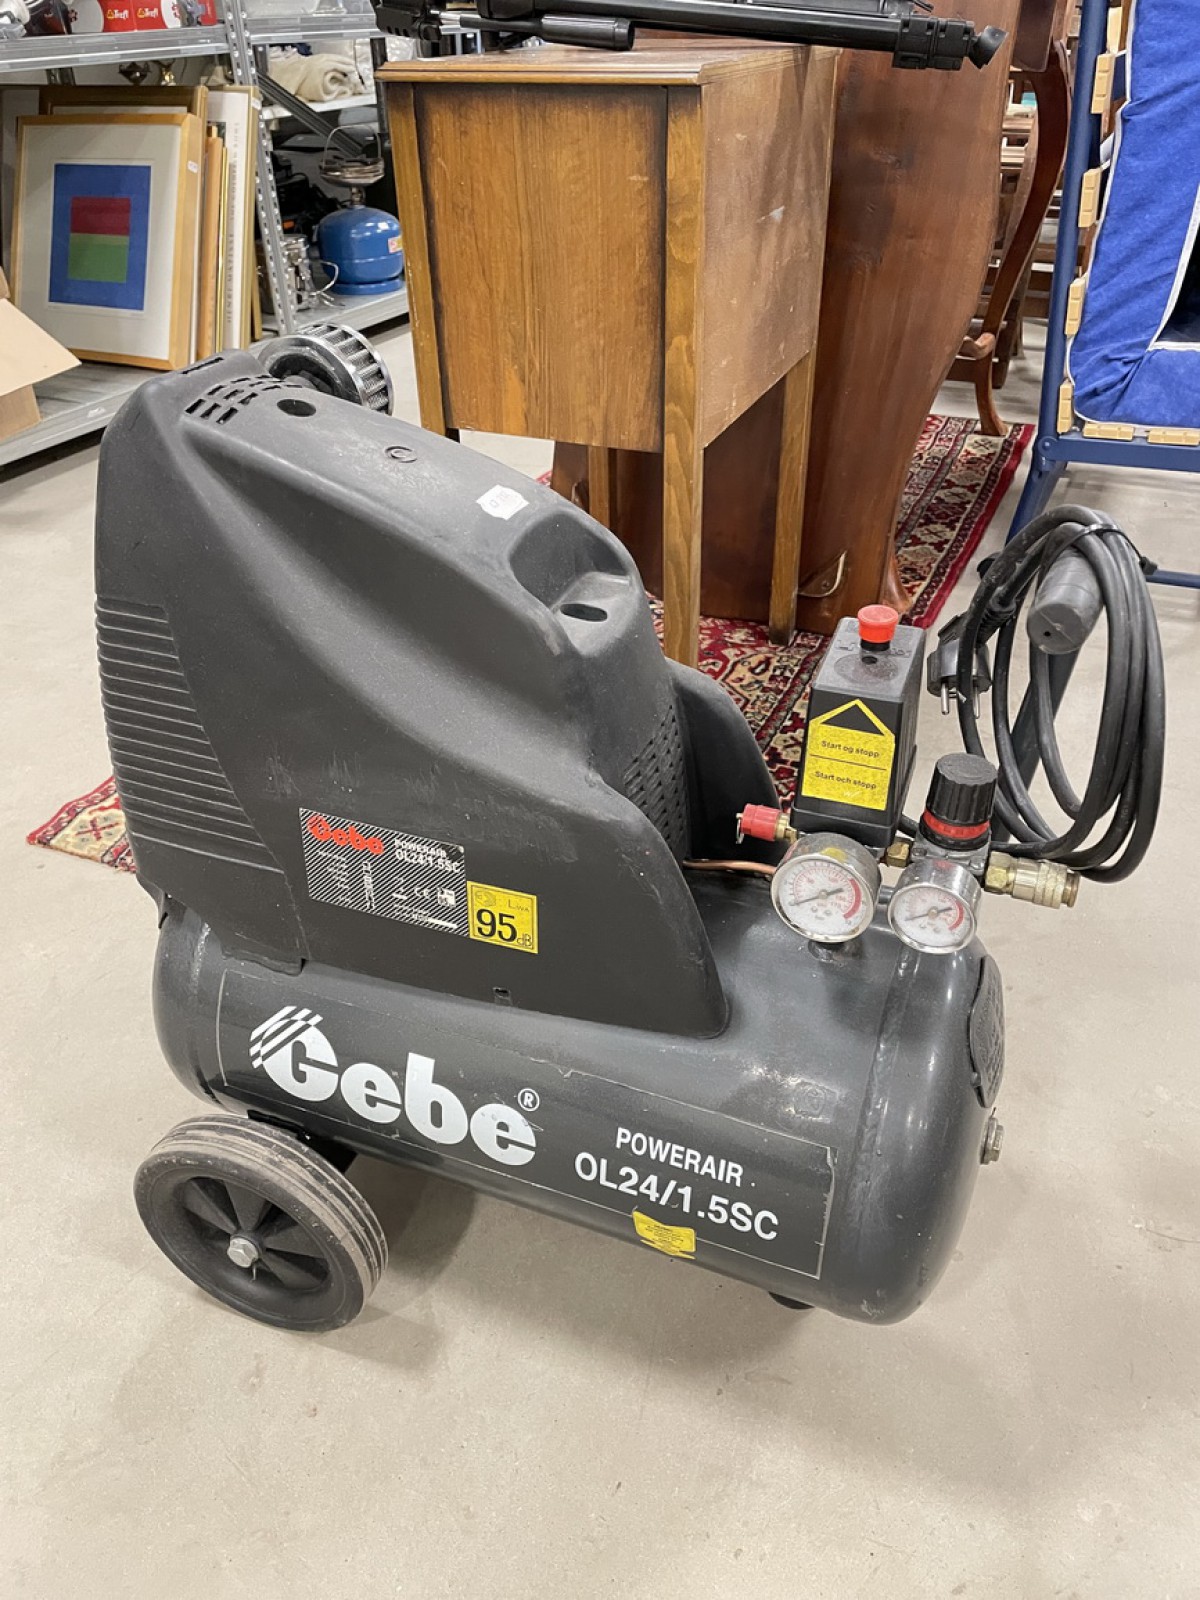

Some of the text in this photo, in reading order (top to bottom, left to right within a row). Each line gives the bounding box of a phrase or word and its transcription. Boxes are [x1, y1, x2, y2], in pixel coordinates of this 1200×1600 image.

[821, 740, 880, 758] Start og stopp
[815, 771, 877, 790] Start och stopp
[307, 813, 385, 855] Gebe
[476, 908, 518, 943] 95
[517, 933, 533, 947] dB
[615, 1127, 744, 1188] POWERAIR
[574, 1151, 780, 1241] OL24/1.5SC
